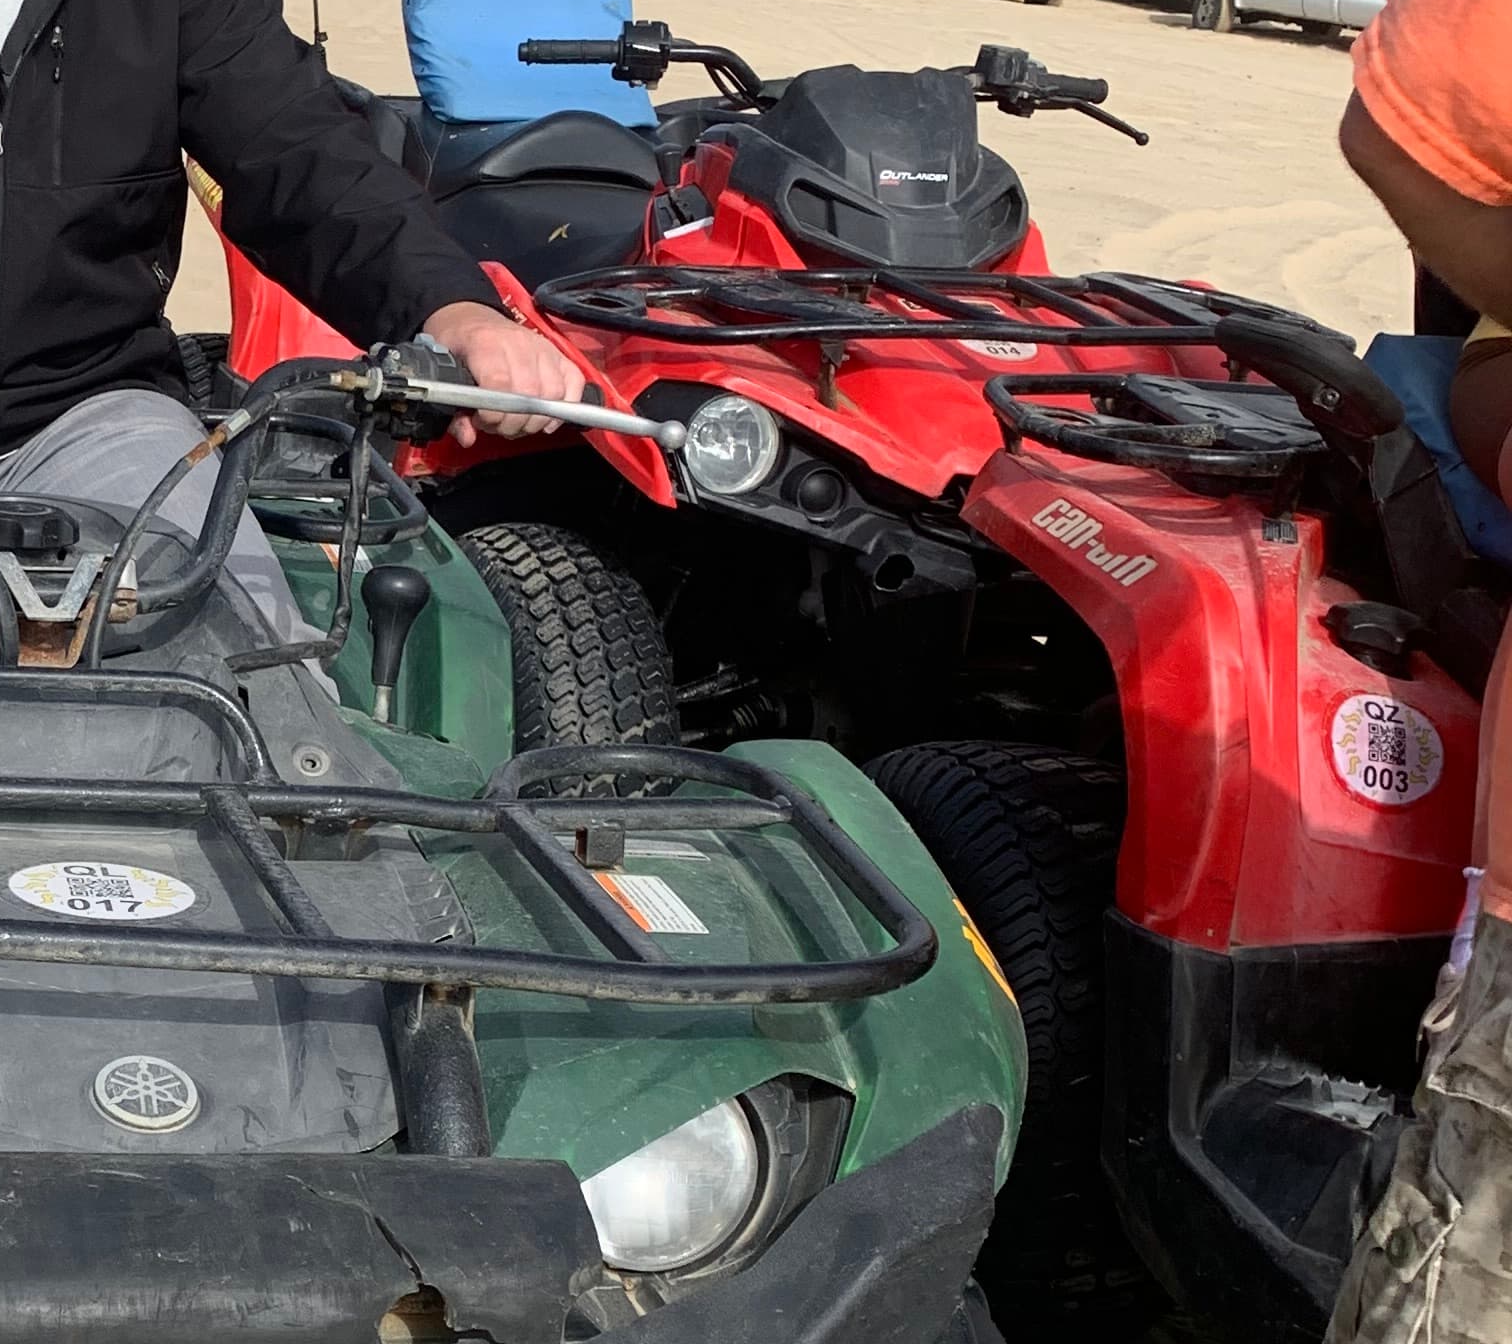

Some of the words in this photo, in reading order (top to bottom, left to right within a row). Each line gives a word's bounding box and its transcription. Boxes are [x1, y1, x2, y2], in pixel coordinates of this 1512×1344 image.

[879, 170, 949, 182] OUTLANDER
[1364, 701, 1404, 724] QZ
[1364, 765, 1408, 793] 003
[63, 865, 126, 877] QL
[67, 898, 145, 912] 017
